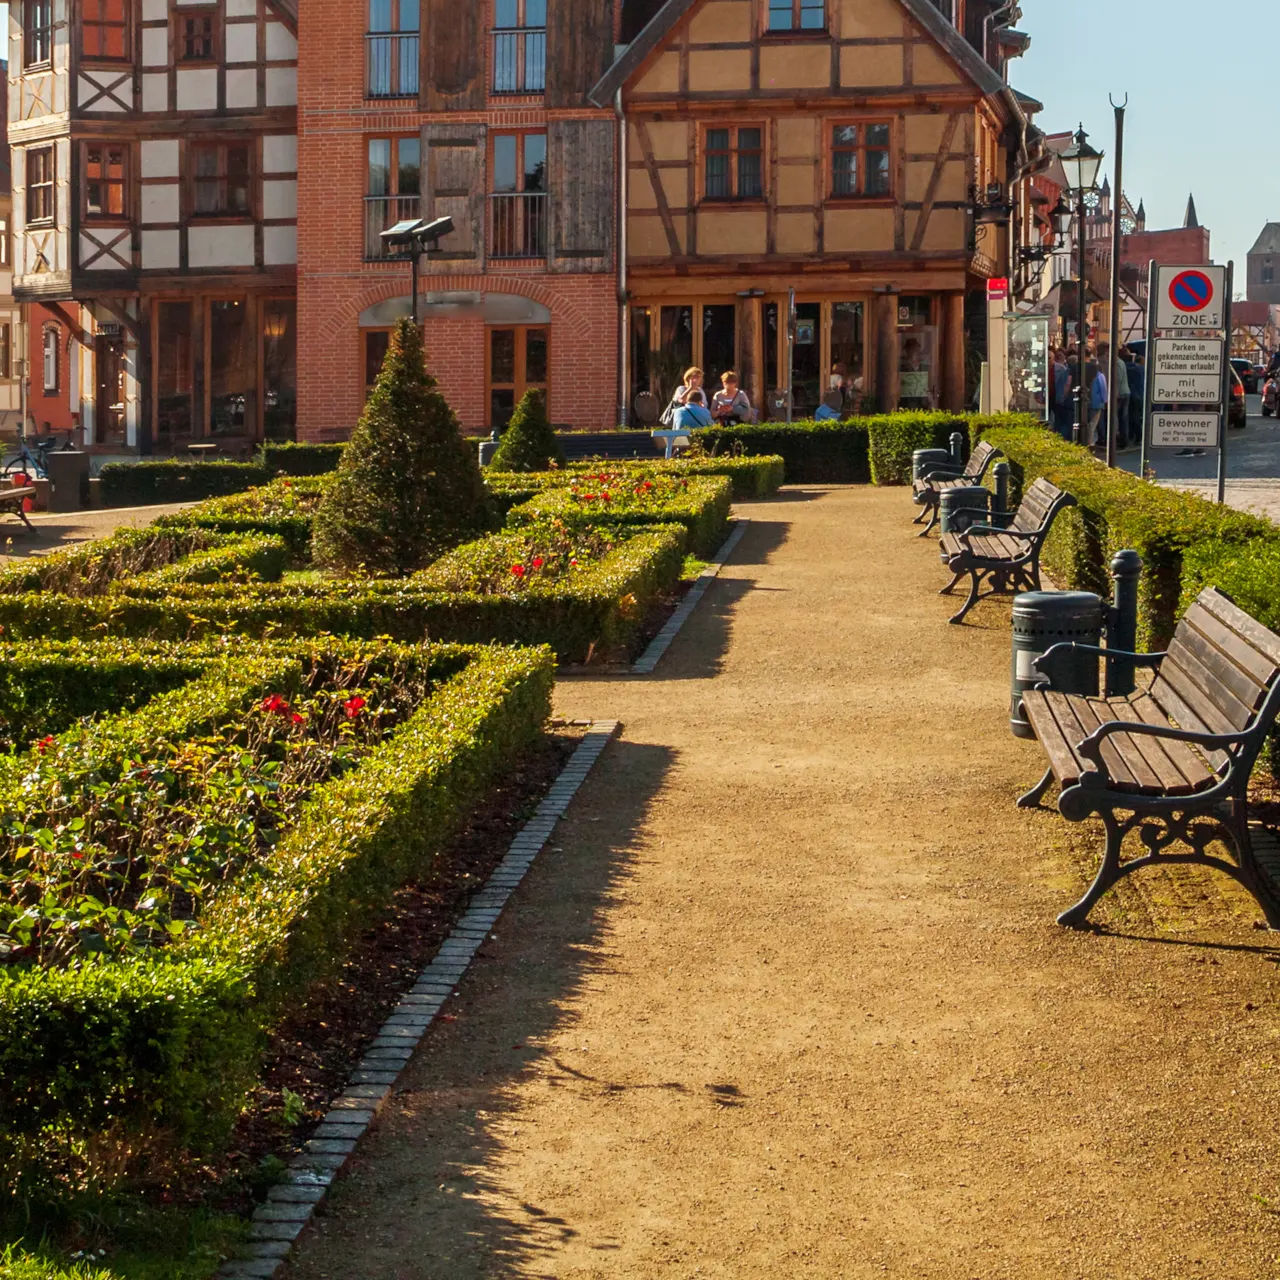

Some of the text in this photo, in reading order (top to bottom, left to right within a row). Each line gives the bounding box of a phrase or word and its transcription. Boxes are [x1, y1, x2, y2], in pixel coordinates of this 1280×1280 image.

[1172, 315, 1207, 326] ZONE
[1172, 343, 1206, 351] Parken in
[1157, 353, 1219, 362] gekennzeichneten
[1160, 362, 1188, 370] Flächen
[1178, 378, 1196, 387] mit
[1158, 388, 1216, 398] Parkschein
[1158, 418, 1212, 428] Bewohner
